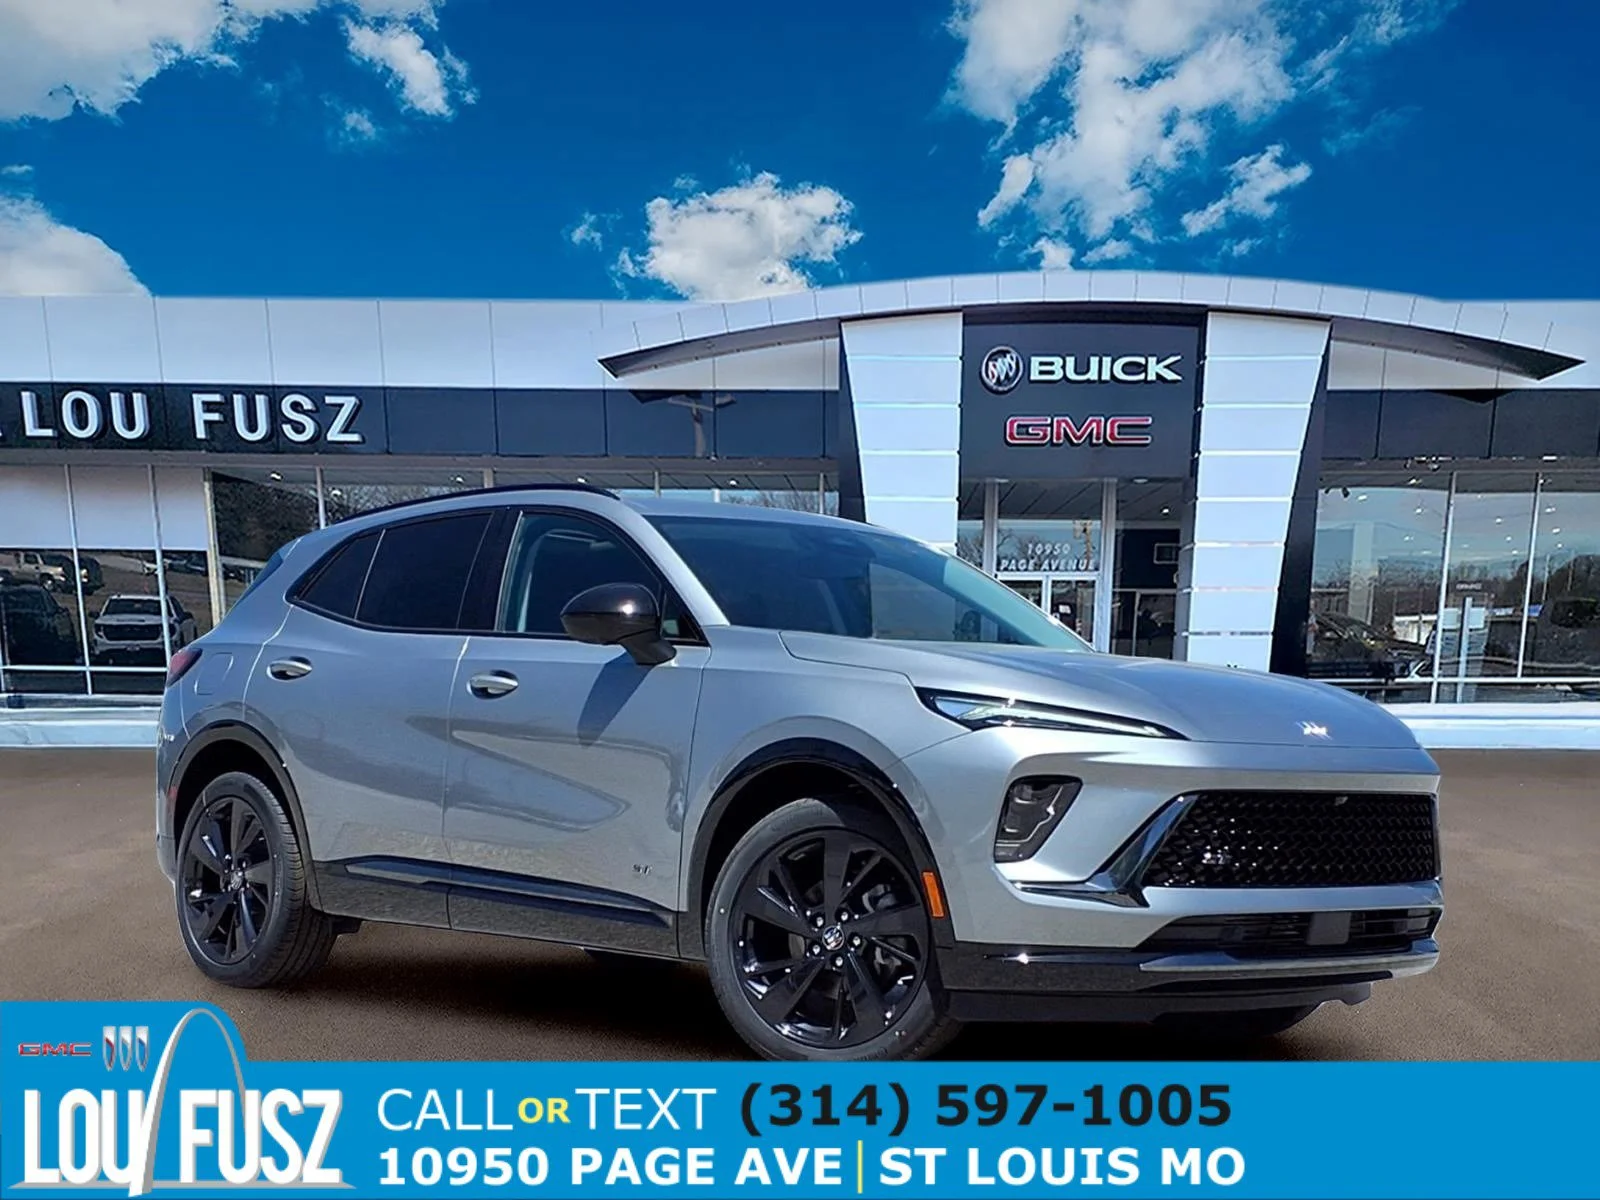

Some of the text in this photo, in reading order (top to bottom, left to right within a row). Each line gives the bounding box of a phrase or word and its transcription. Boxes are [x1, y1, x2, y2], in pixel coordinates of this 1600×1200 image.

[1029, 355, 1182, 381] BUICK
[20, 390, 364, 443] LOU FUSZ
[1006, 415, 1153, 445] GMC
[1027, 543, 1071, 555] 10950
[1000, 558, 1096, 571] PAGE AVENUE
